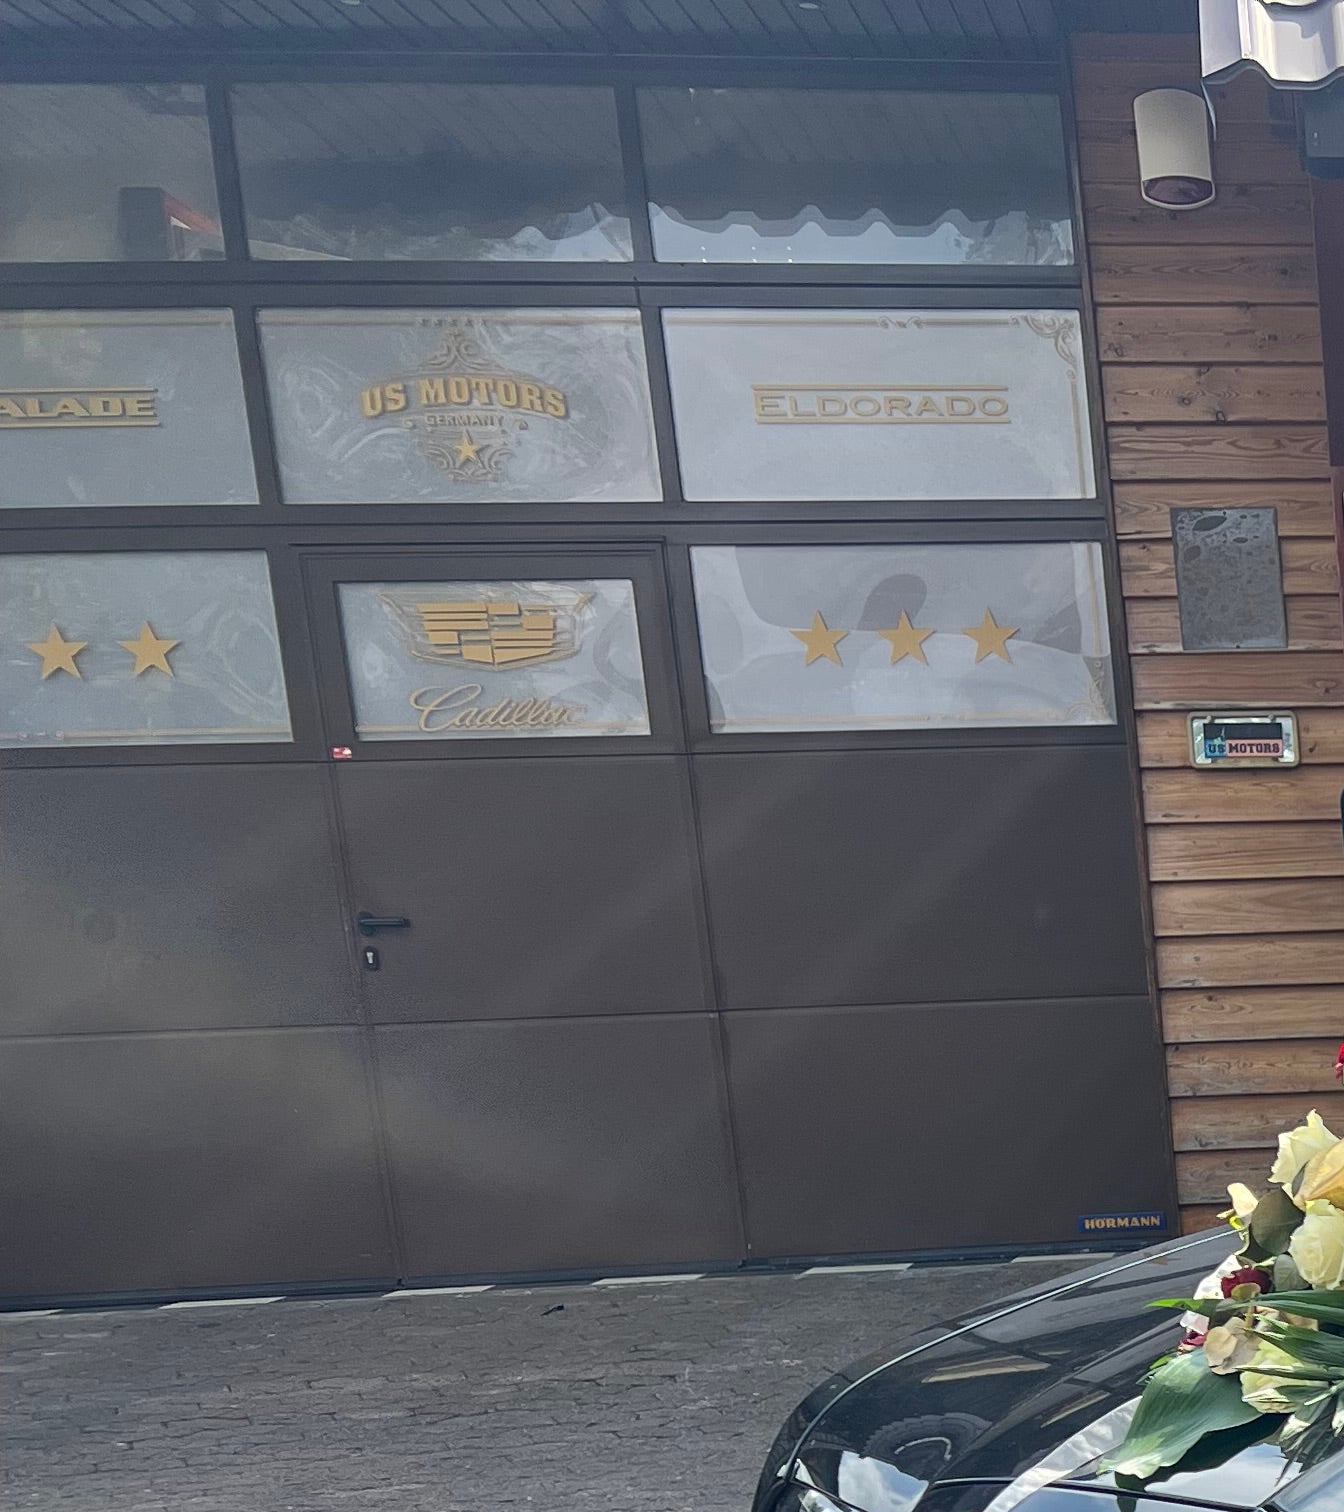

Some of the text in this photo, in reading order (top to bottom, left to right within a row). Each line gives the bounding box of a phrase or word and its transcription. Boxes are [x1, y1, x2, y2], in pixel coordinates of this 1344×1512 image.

[361, 376, 569, 418] US MOTORS
[757, 394, 1008, 417] ELDORADO
[424, 414, 504, 428] GERMANY
[408, 683, 587, 733] Cadillac
[1207, 743, 1227, 754] US
[1228, 742, 1280, 754] MOTORS
